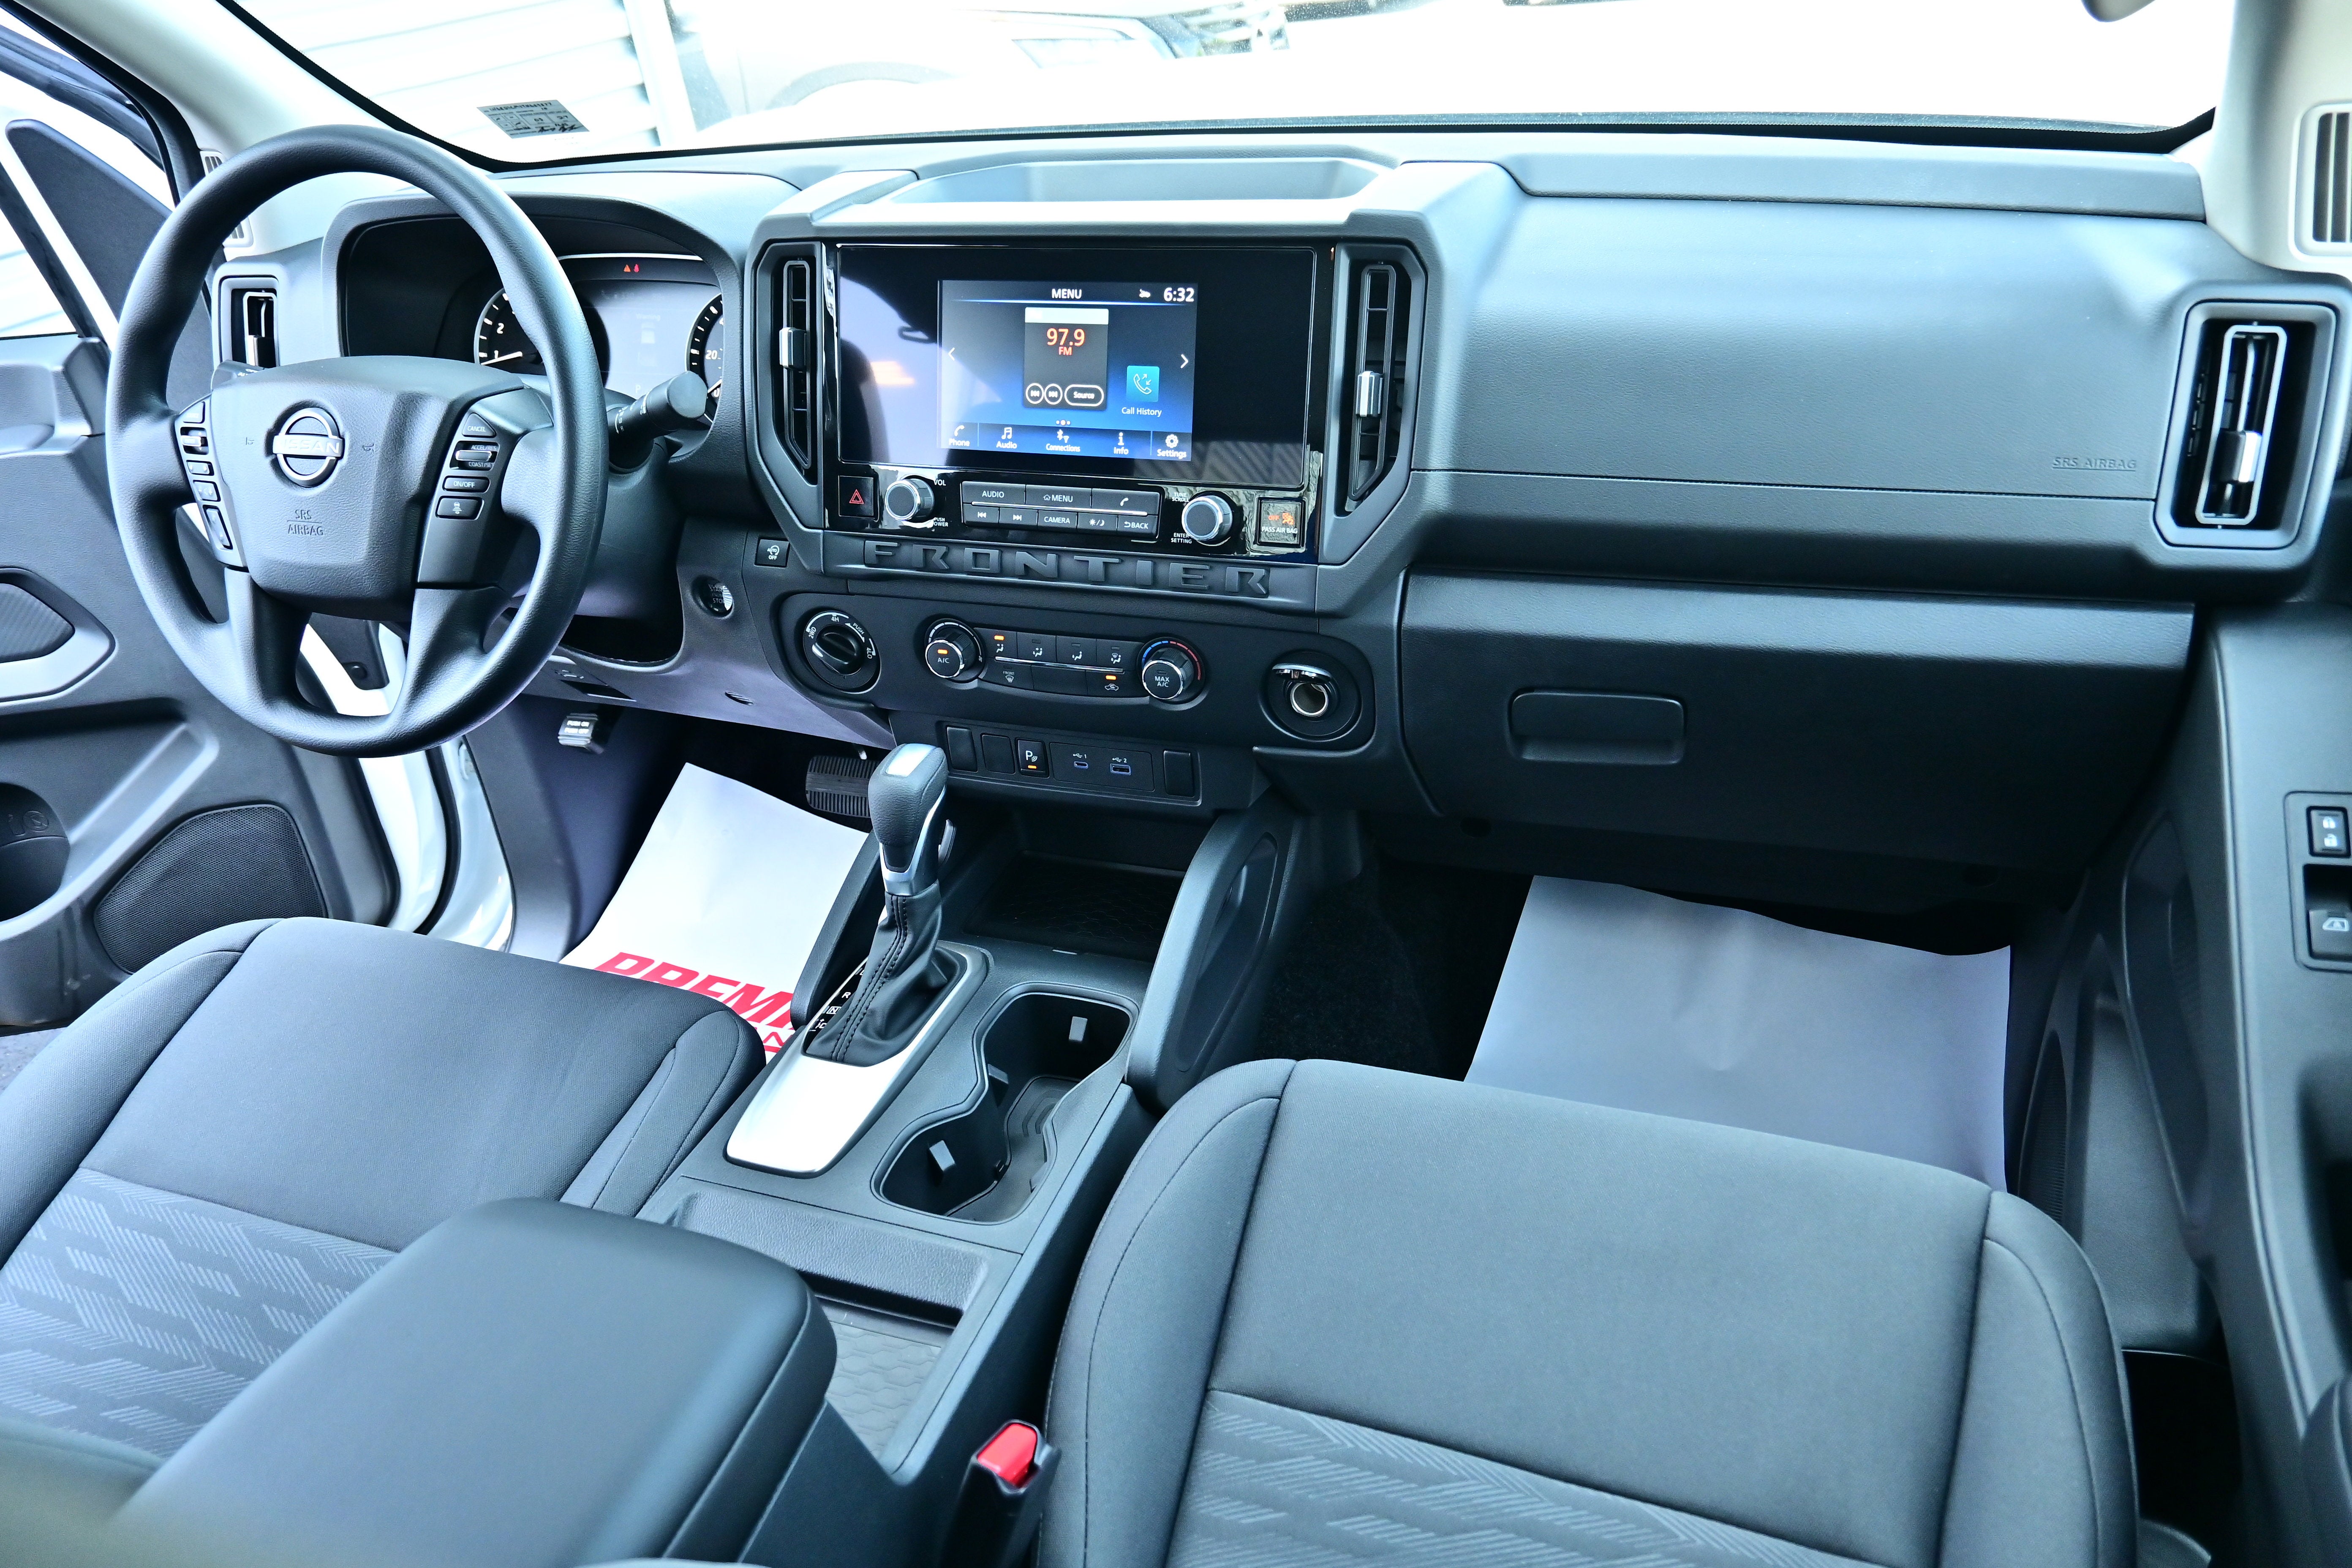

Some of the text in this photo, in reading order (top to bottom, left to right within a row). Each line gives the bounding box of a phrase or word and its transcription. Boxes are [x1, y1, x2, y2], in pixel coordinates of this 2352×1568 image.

[1052, 289, 1082, 299] MENU
[1164, 287, 1194, 302] 6:32
[497, 323, 504, 334] 2
[1047, 328, 1085, 346] 97.9
[705, 350, 718, 359] 20
[1059, 346, 1072, 355] FM
[1073, 391, 1095, 400] Source
[1122, 407, 1162, 417] Call History
[276, 438, 340, 454] ISSAN
[949, 438, 970, 447] Phone
[996, 441, 1017, 449] Audio
[1045, 443, 1081, 452] Connections
[1114, 446, 1129, 455] Info
[1157, 449, 1187, 459] Settings
[2053, 457, 2137, 470] SRS AIRBAG
[1052, 494, 1073, 503] MENU
[295, 509, 312, 520] SRS
[1044, 516, 1070, 524] CAMERA
[288, 525, 324, 536] AIRBAG
[864, 540, 1269, 595] FRONTIER
[808, 626, 817, 639] 2WD
[852, 622, 865, 635] PUSH
[1025, 750, 1033, 761] P
[593, 952, 794, 1031] PREM
